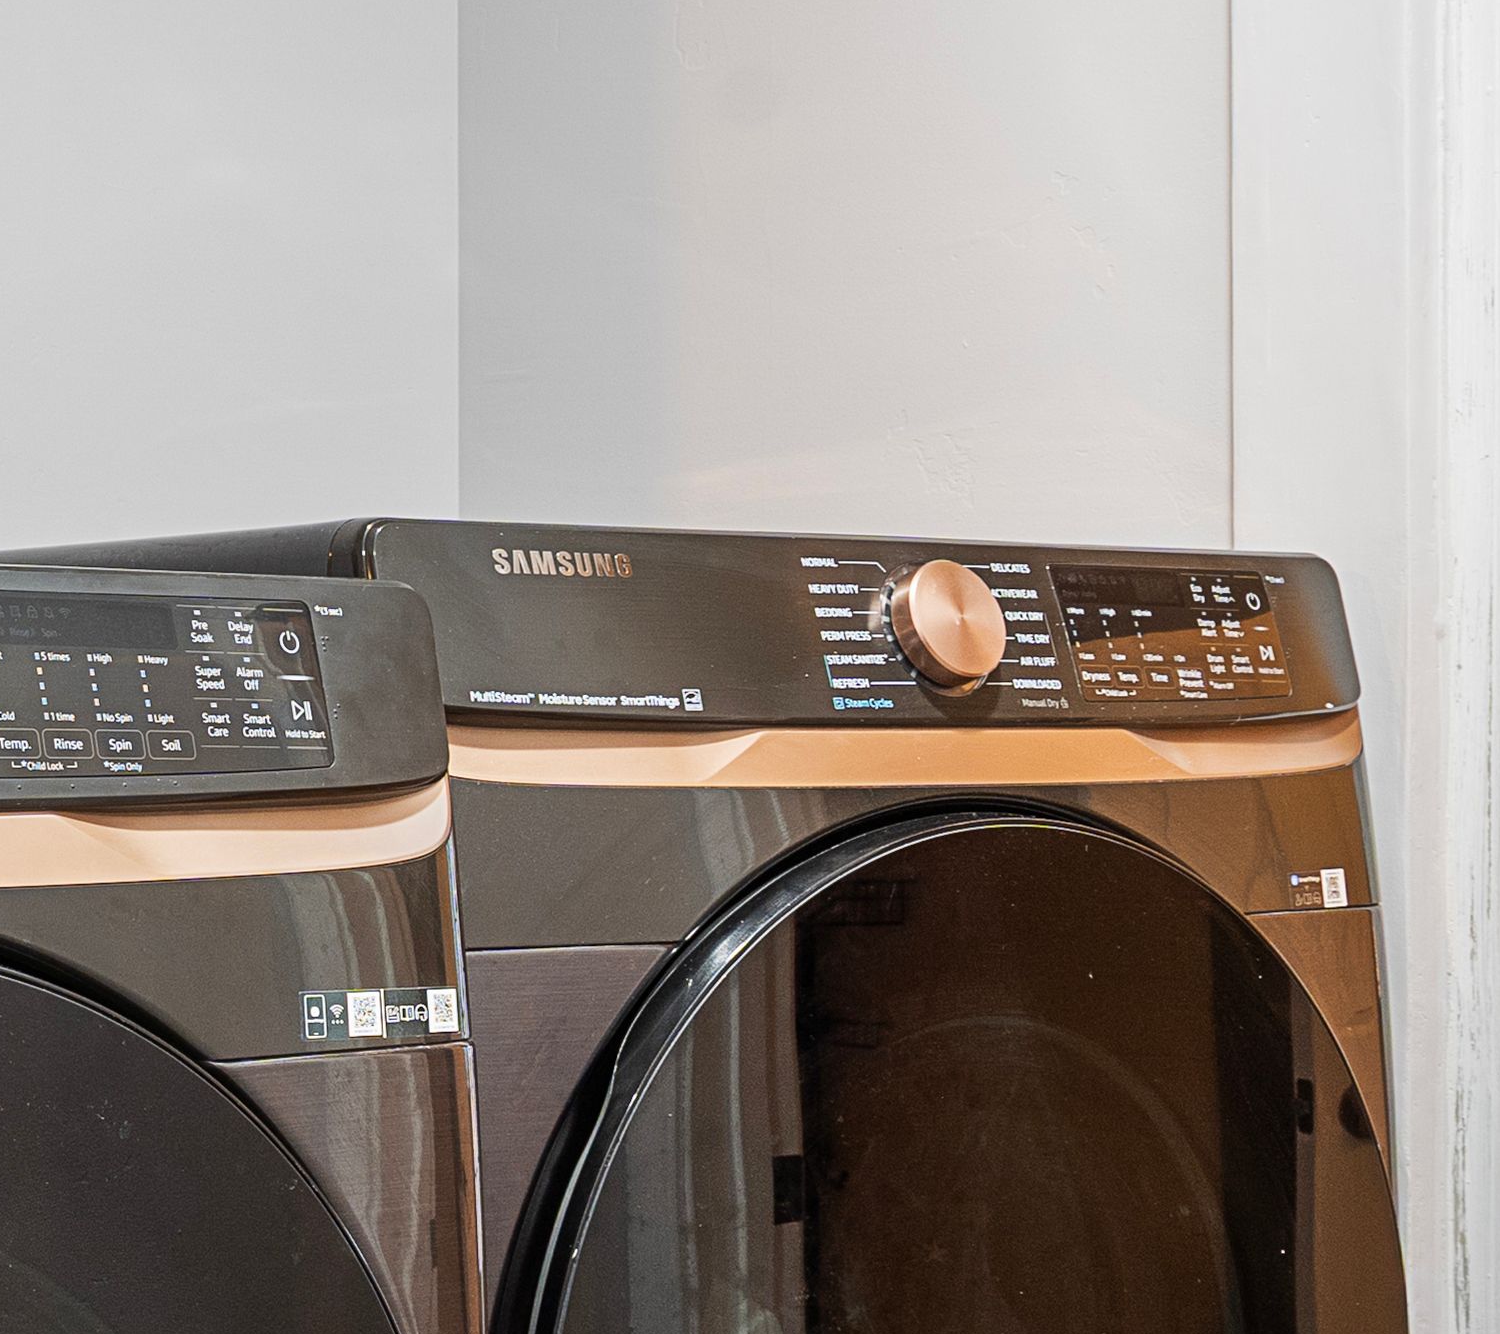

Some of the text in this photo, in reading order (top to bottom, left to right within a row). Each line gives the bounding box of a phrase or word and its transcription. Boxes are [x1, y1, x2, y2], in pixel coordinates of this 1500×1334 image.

[492, 548, 633, 577] SAMSUNG
[800, 557, 838, 567] NORMAL
[990, 563, 1030, 574] DELICATES
[808, 584, 858, 594] HEAVY DUTY
[814, 608, 852, 617] BEDDING
[1005, 611, 1044, 621] QUICK DRY
[191, 620, 208, 630] Pre
[228, 621, 253, 634] Delay
[190, 632, 214, 643] Soak
[234, 634, 252, 645] End
[820, 631, 872, 641] PERM PRESS
[1015, 633, 1050, 644] TIME DRY
[41, 652, 71, 661] 5 times
[93, 654, 112, 664] High
[144, 655, 168, 665] Heavy
[827, 654, 852, 664] STEAM
[1020, 657, 1056, 666] AIR FLUFF
[195, 666, 221, 677] Super
[236, 667, 263, 678] Alarm
[196, 679, 225, 691] Speed
[244, 680, 259, 691] Off
[833, 678, 870, 688] REFRESH
[1012, 678, 1062, 690] DOWNLOADED
[539, 693, 583, 706] Moisture
[584, 695, 617, 707] Sensor
[620, 696, 680, 709] SmartThings
[845, 698, 894, 710] Steam Cycles
[1022, 699, 1059, 709] Manual Dry
[56, 713, 75, 722] time
[103, 714, 133, 724] No Spin
[154, 715, 174, 724] Light
[202, 713, 230, 724] Smart
[243, 714, 271, 725] Smart
[208, 727, 229, 737] Care
[243, 727, 276, 738] Control
[285, 730, 301, 738] Hold
[309, 731, 326, 739] Start
[54, 738, 83, 750] Rinse
[109, 739, 132, 752] Spin
[162, 740, 181, 751] Soil
[47, 762, 64, 770] Lock
[126, 763, 142, 772] Only
